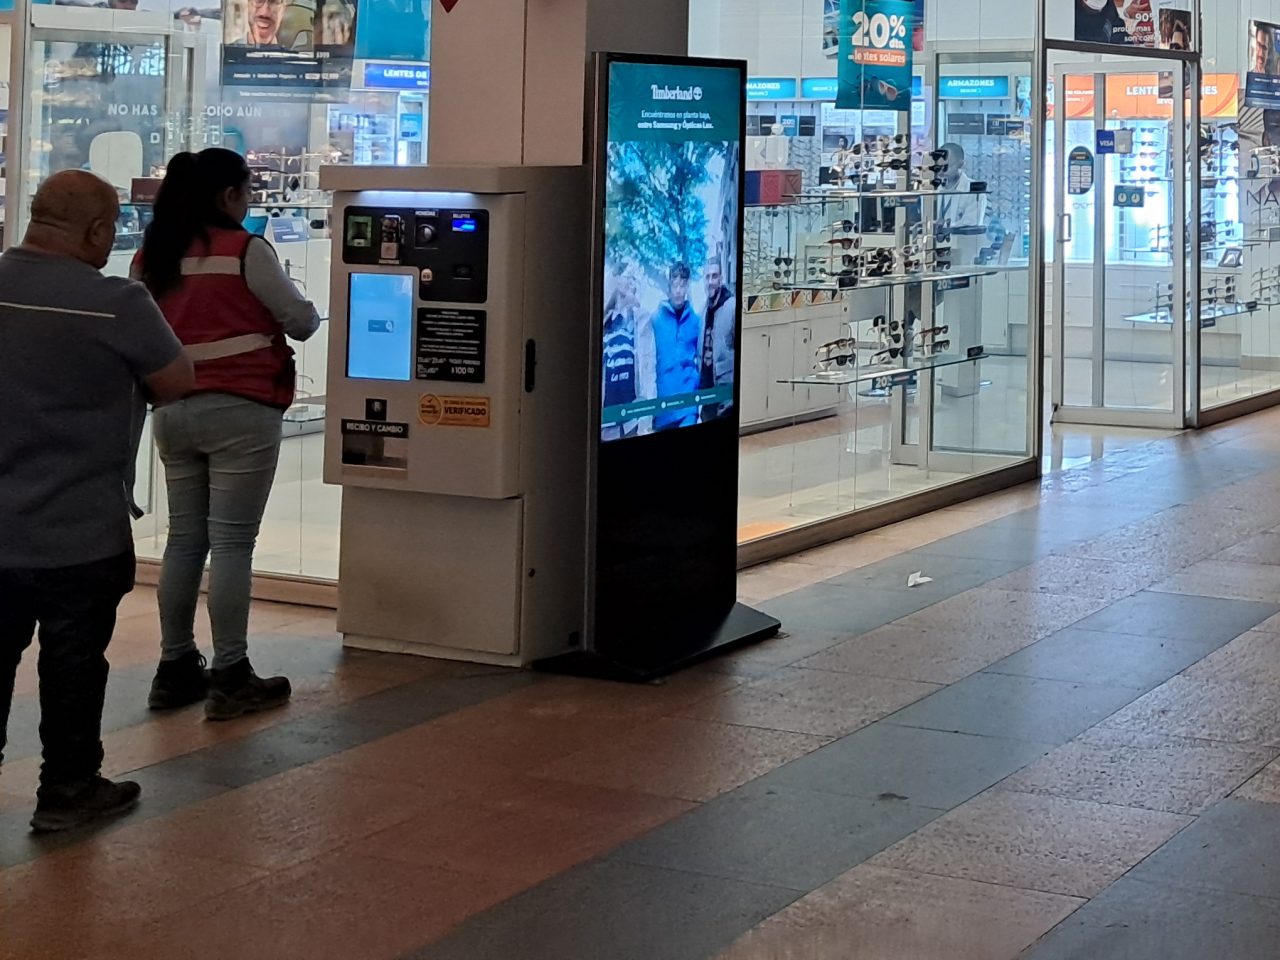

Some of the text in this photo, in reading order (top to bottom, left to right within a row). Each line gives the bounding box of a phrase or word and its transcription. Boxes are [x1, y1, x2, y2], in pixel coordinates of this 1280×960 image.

[851, 11, 906, 48] 20%
[879, 53, 905, 64] solares
[746, 82, 781, 90] MAZONES
[947, 79, 995, 87] ARMAZONES
[651, 84, 693, 101] Timberland
[1126, 86, 1159, 96] LENTE
[108, 104, 129, 116] NO
[132, 104, 158, 116] HAS
[444, 406, 487, 416] VERIFICADO
[346, 422, 370, 431] RECIBO
[376, 424, 403, 433] CAMBIO
